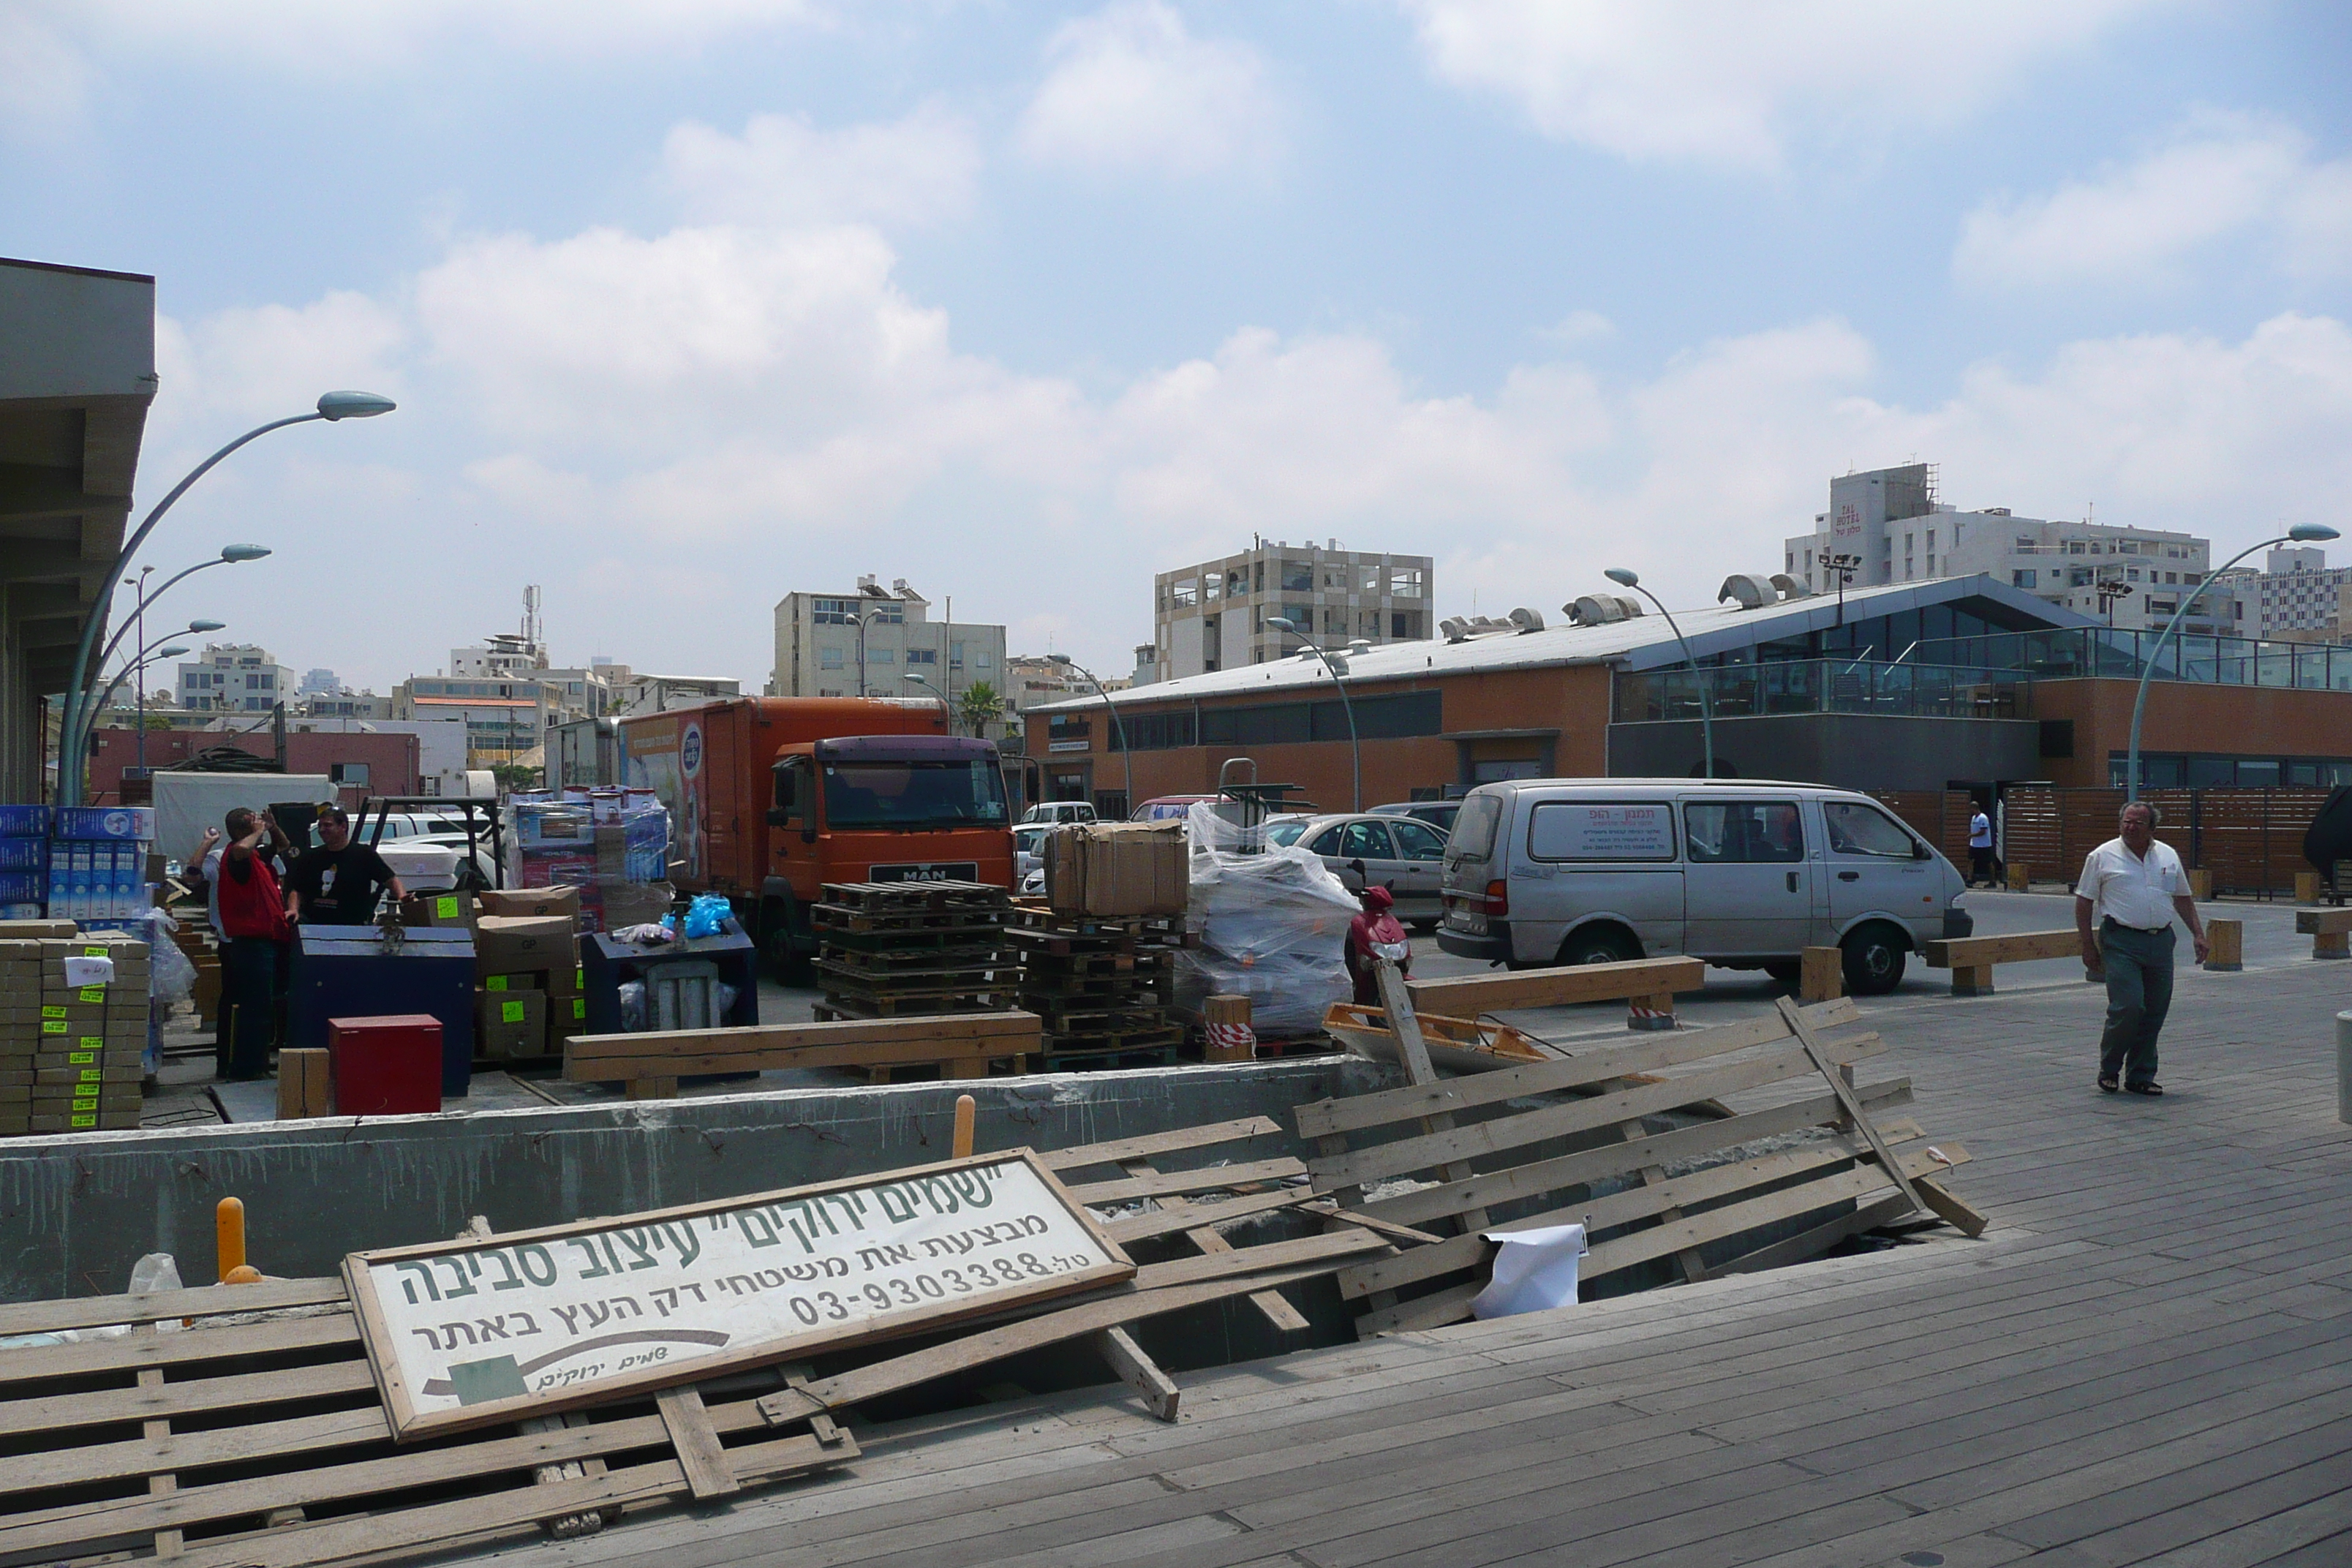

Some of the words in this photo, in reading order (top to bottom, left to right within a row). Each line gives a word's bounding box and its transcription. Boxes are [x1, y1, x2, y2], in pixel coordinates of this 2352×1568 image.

[1836, 513, 1860, 526] HOTEL
[1842, 505, 1855, 515] TAL
[1836, 529, 1845, 537] טל
[1847, 525, 1861, 537] מלון
[903, 871, 946, 881] MAN
[535, 905, 548, 915] GP
[522, 939, 537, 949] GP
[565, 1222, 701, 1279] עיצוב
[919, 1214, 1049, 1257] מבצעת
[856, 1241, 917, 1273] את
[395, 1243, 557, 1305] סביבה
[715, 1256, 849, 1296] משטחי
[789, 1251, 1052, 1326] 03-9303388
[551, 1295, 643, 1335] העץ
[649, 1282, 707, 1318] דק
[412, 1311, 542, 1351] באתר
[618, 1346, 668, 1371] שמים
[537, 1363, 606, 1391] ירוקים
